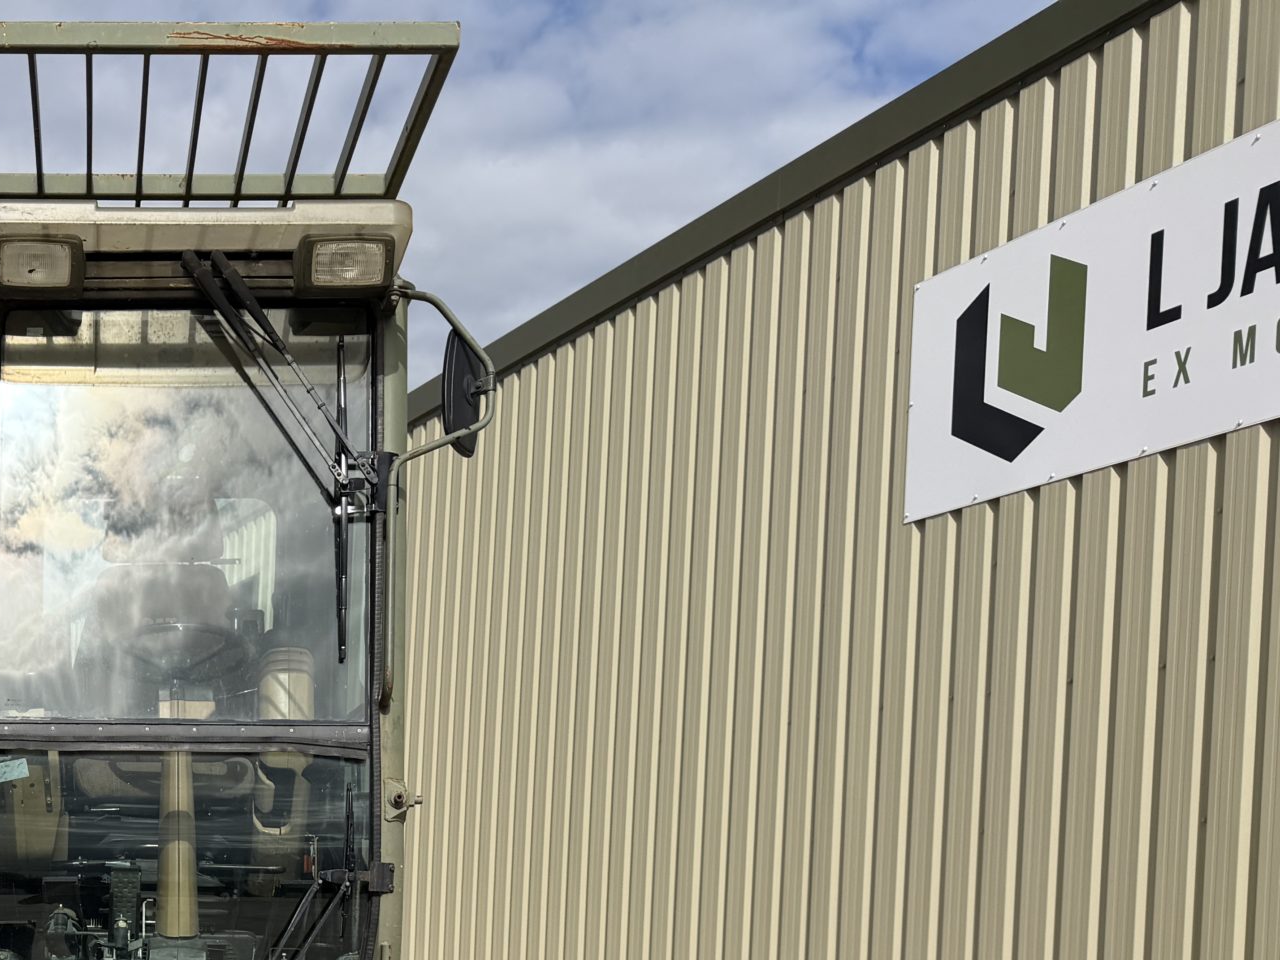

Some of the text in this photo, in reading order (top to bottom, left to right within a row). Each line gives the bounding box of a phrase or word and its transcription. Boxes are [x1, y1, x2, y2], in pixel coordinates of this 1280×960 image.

[1146, 229, 1182, 331] L
[1142, 318, 1280, 398] EX M
